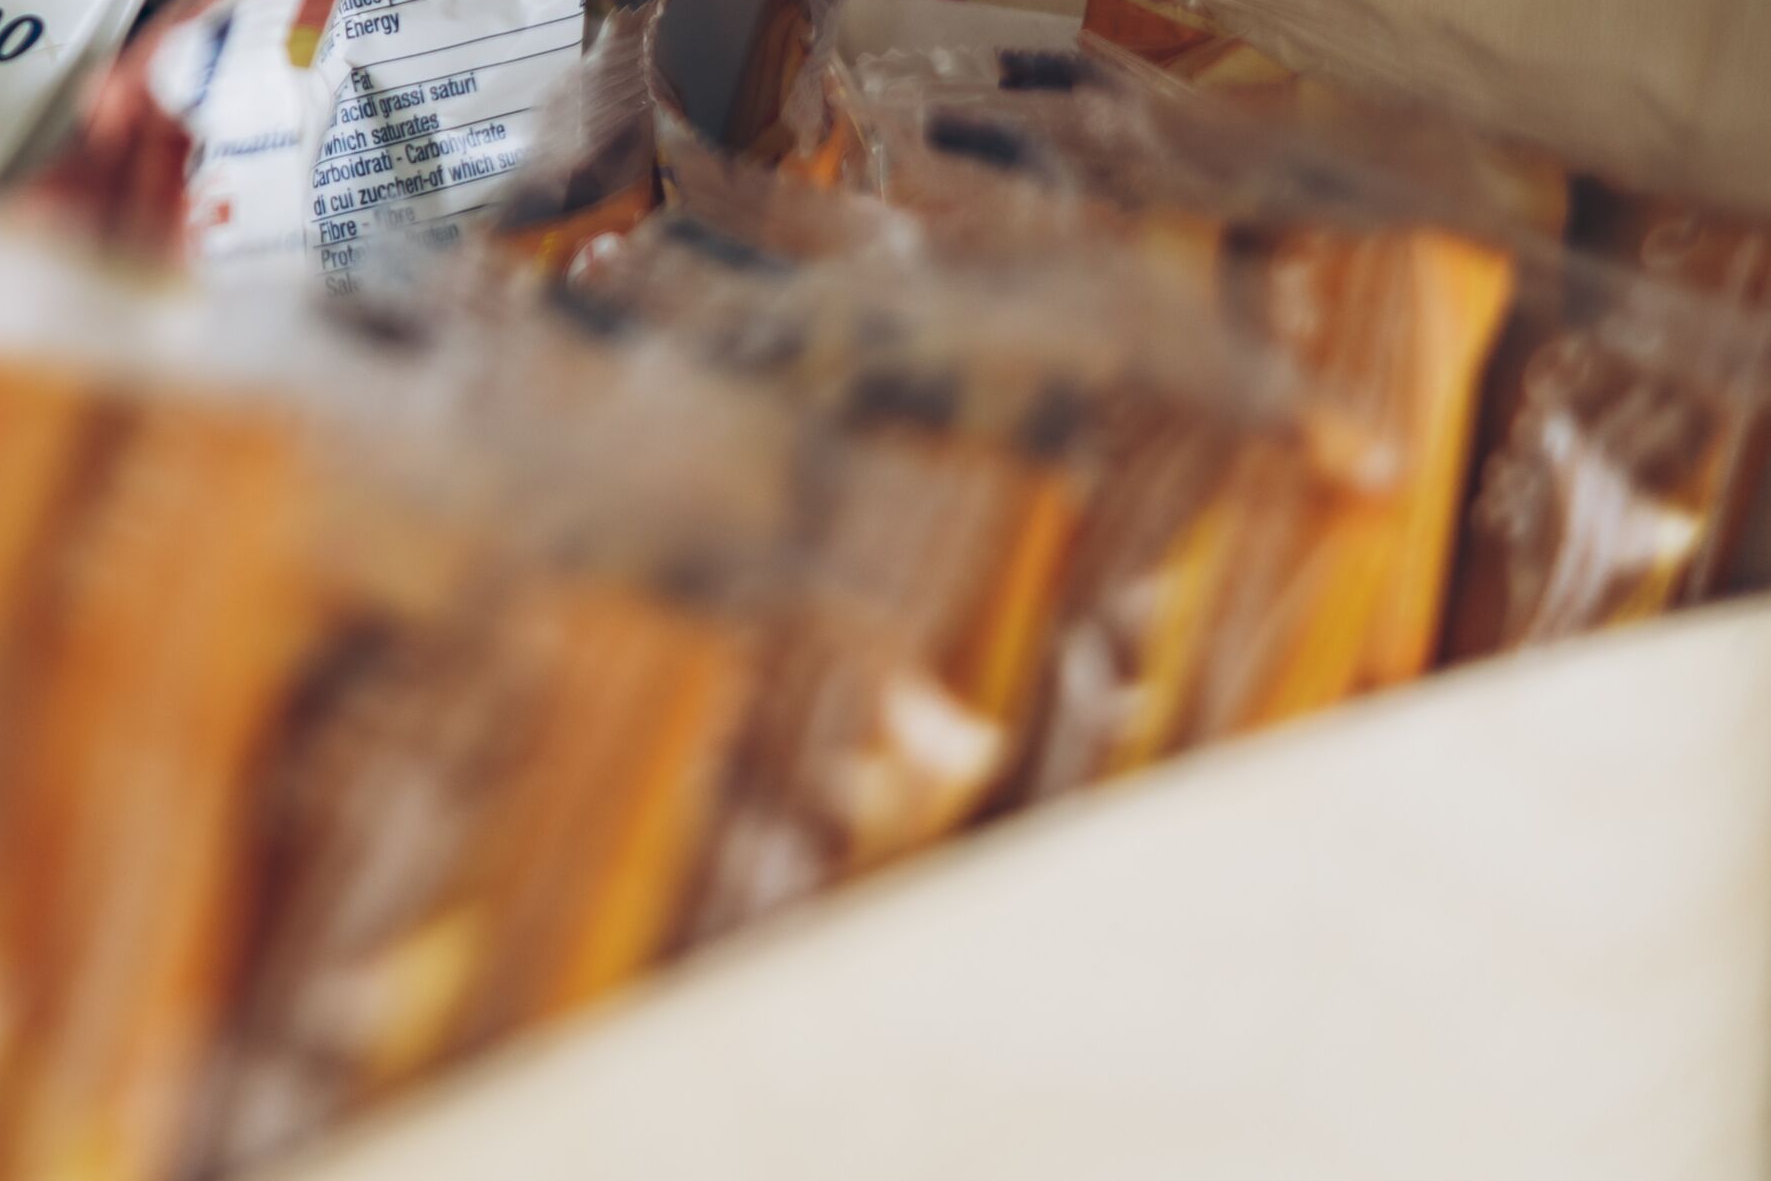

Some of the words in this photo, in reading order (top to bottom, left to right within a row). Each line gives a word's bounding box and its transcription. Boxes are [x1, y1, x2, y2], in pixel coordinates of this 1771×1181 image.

[344, 11, 400, 40] Energy
[340, 97, 378, 124] acidi
[379, 84, 425, 119] grassi
[429, 71, 478, 102] saturi
[350, 69, 374, 93] Fat
[311, 150, 394, 189] Carboidrati
[404, 122, 507, 165] Carbohydrate
[324, 128, 368, 157] which
[370, 112, 440, 146] saturates
[313, 194, 327, 217] di
[330, 187, 355, 213] cui
[448, 153, 495, 182] which
[319, 218, 358, 244] Fibre
